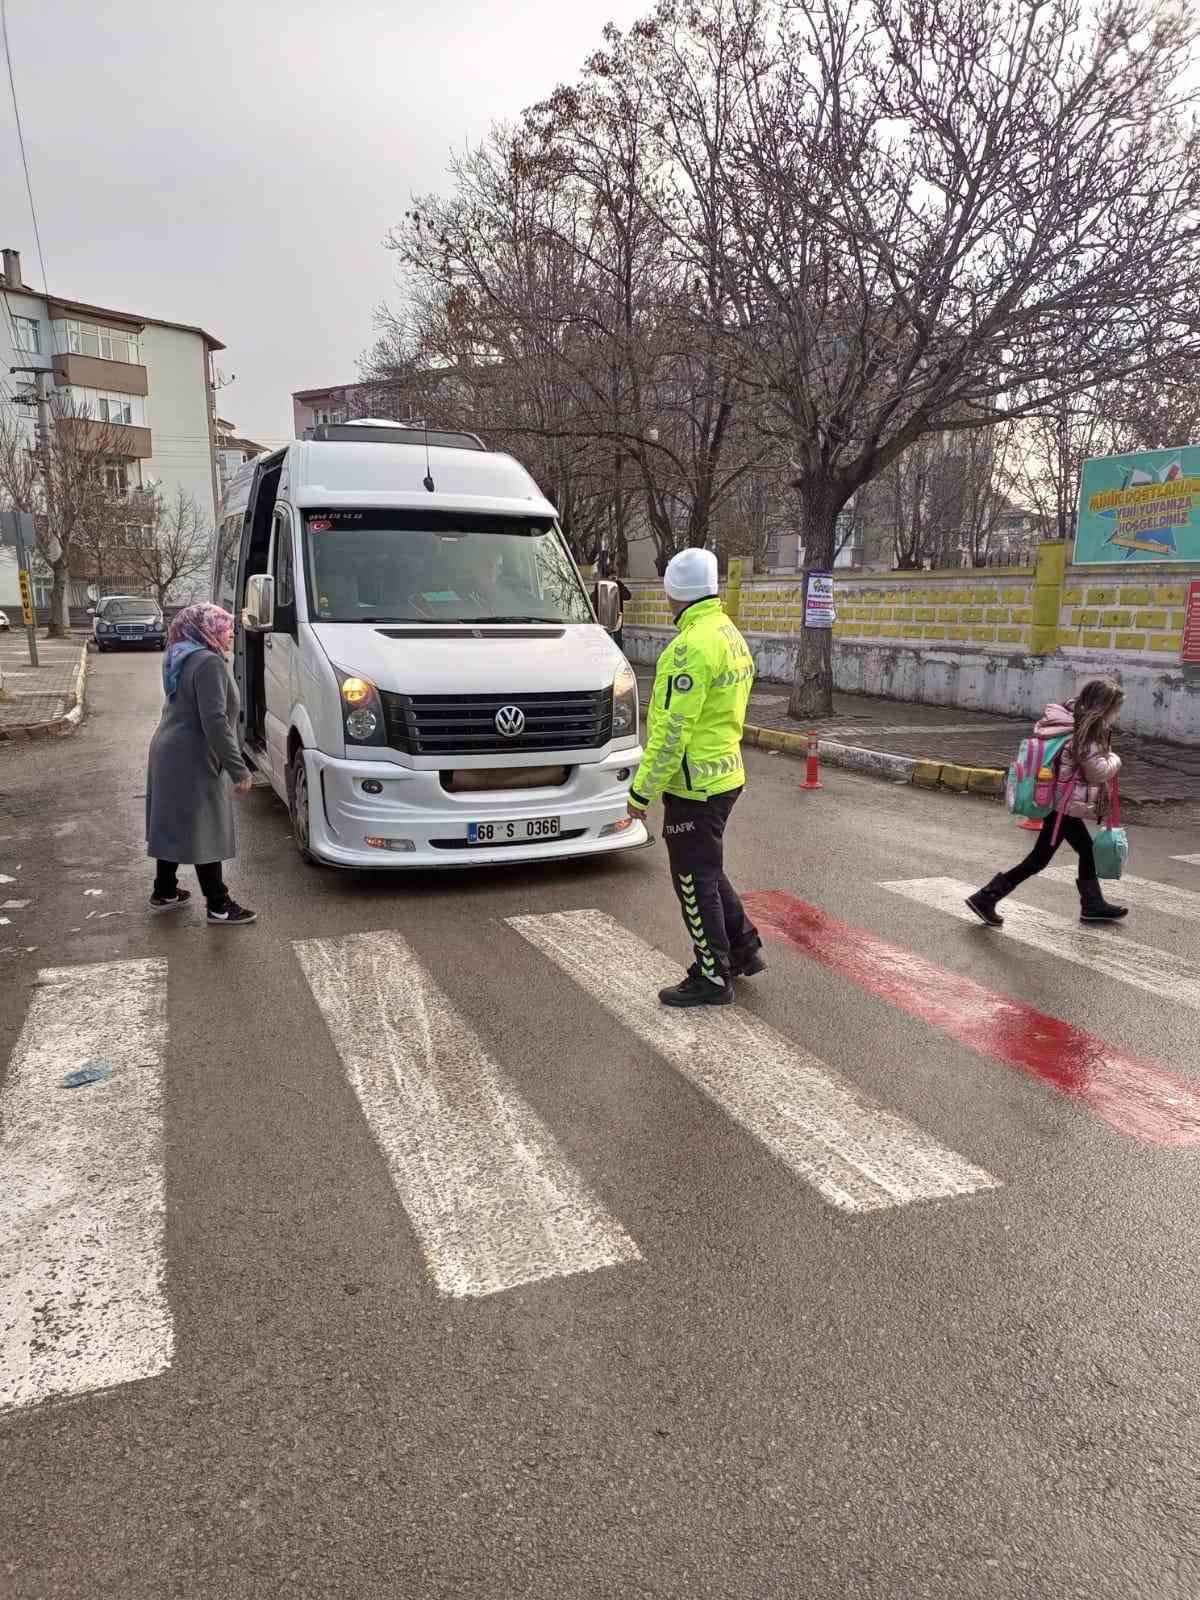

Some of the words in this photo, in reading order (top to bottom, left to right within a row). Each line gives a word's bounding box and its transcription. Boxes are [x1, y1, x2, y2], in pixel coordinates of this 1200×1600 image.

[478, 824, 494, 840] 68
[506, 823, 515, 838] S
[527, 819, 558, 836] 0366
